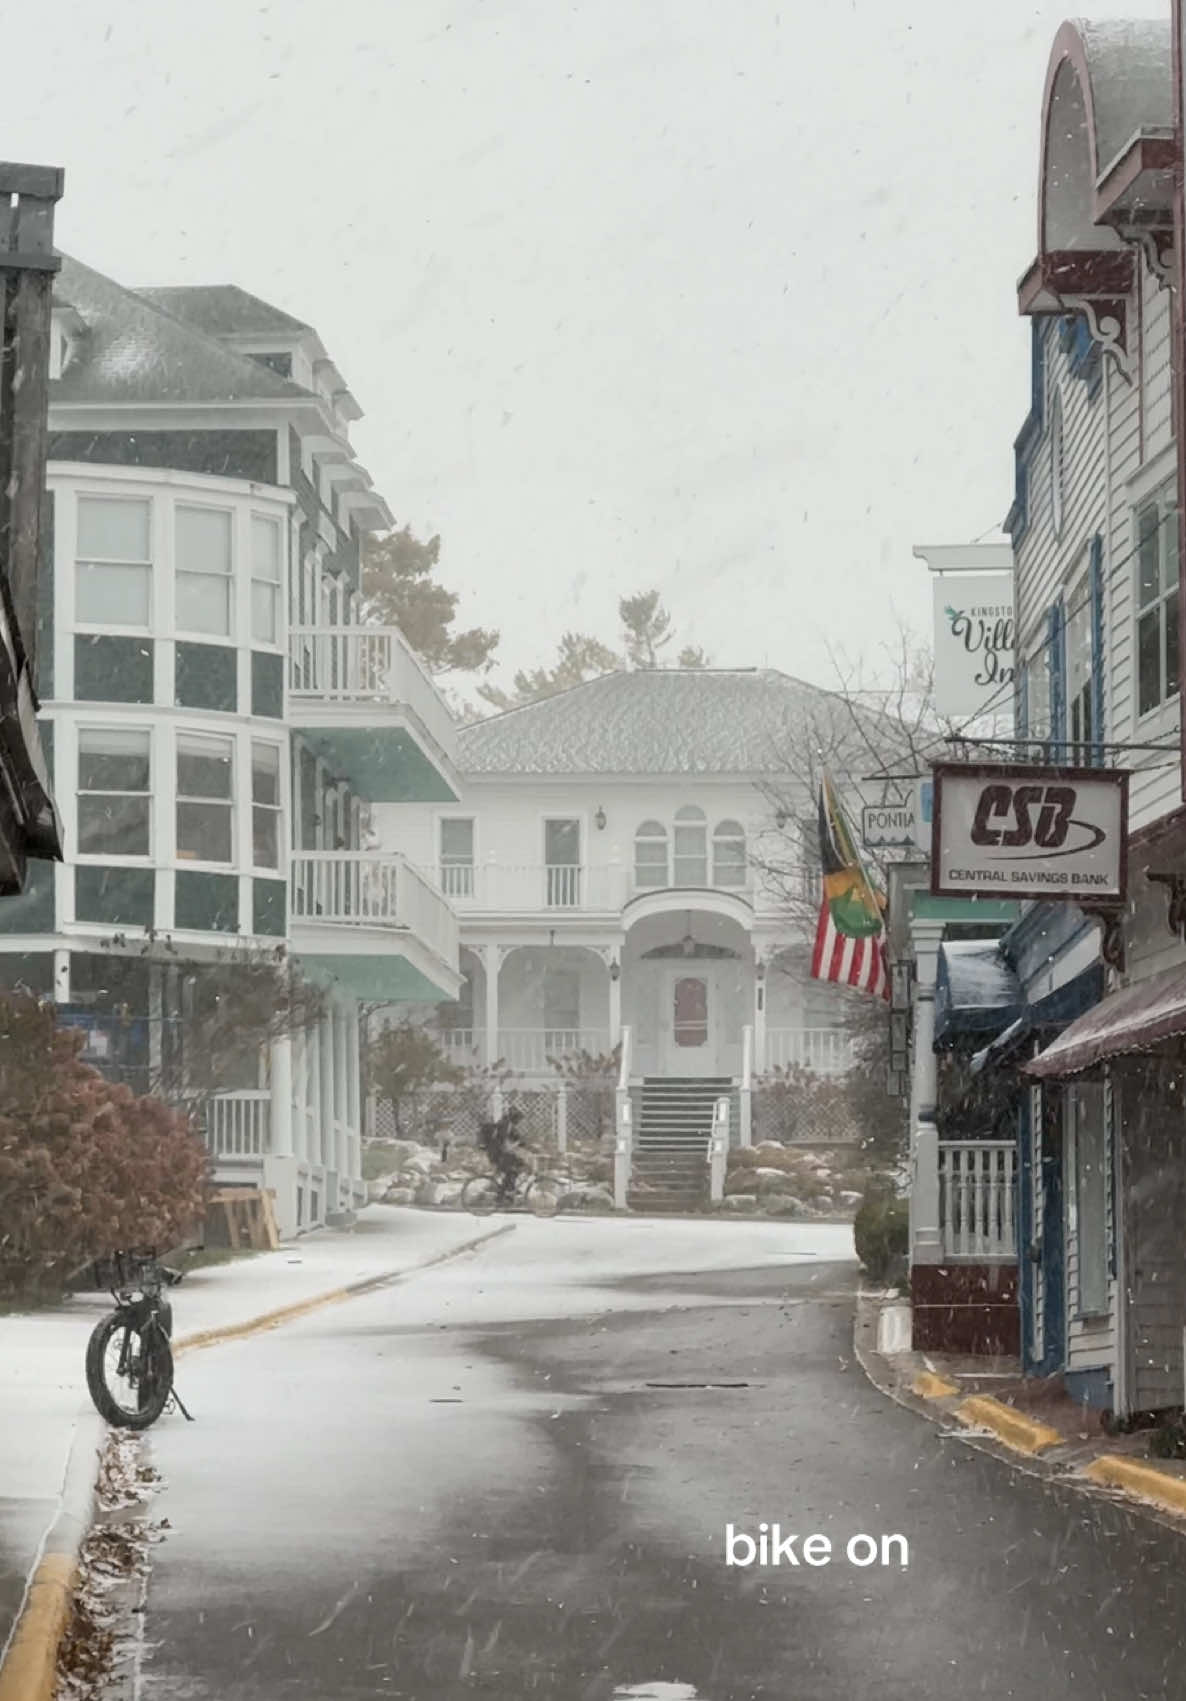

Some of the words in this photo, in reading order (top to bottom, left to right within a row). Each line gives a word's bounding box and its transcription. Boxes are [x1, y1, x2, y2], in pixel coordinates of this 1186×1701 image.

[952, 616, 1015, 653] Vill
[970, 785, 1077, 848] CSB
[949, 869, 1007, 882] CENTRAL
[1011, 871, 1068, 884] SAVINGS
[1071, 873, 1108, 885] BANK
